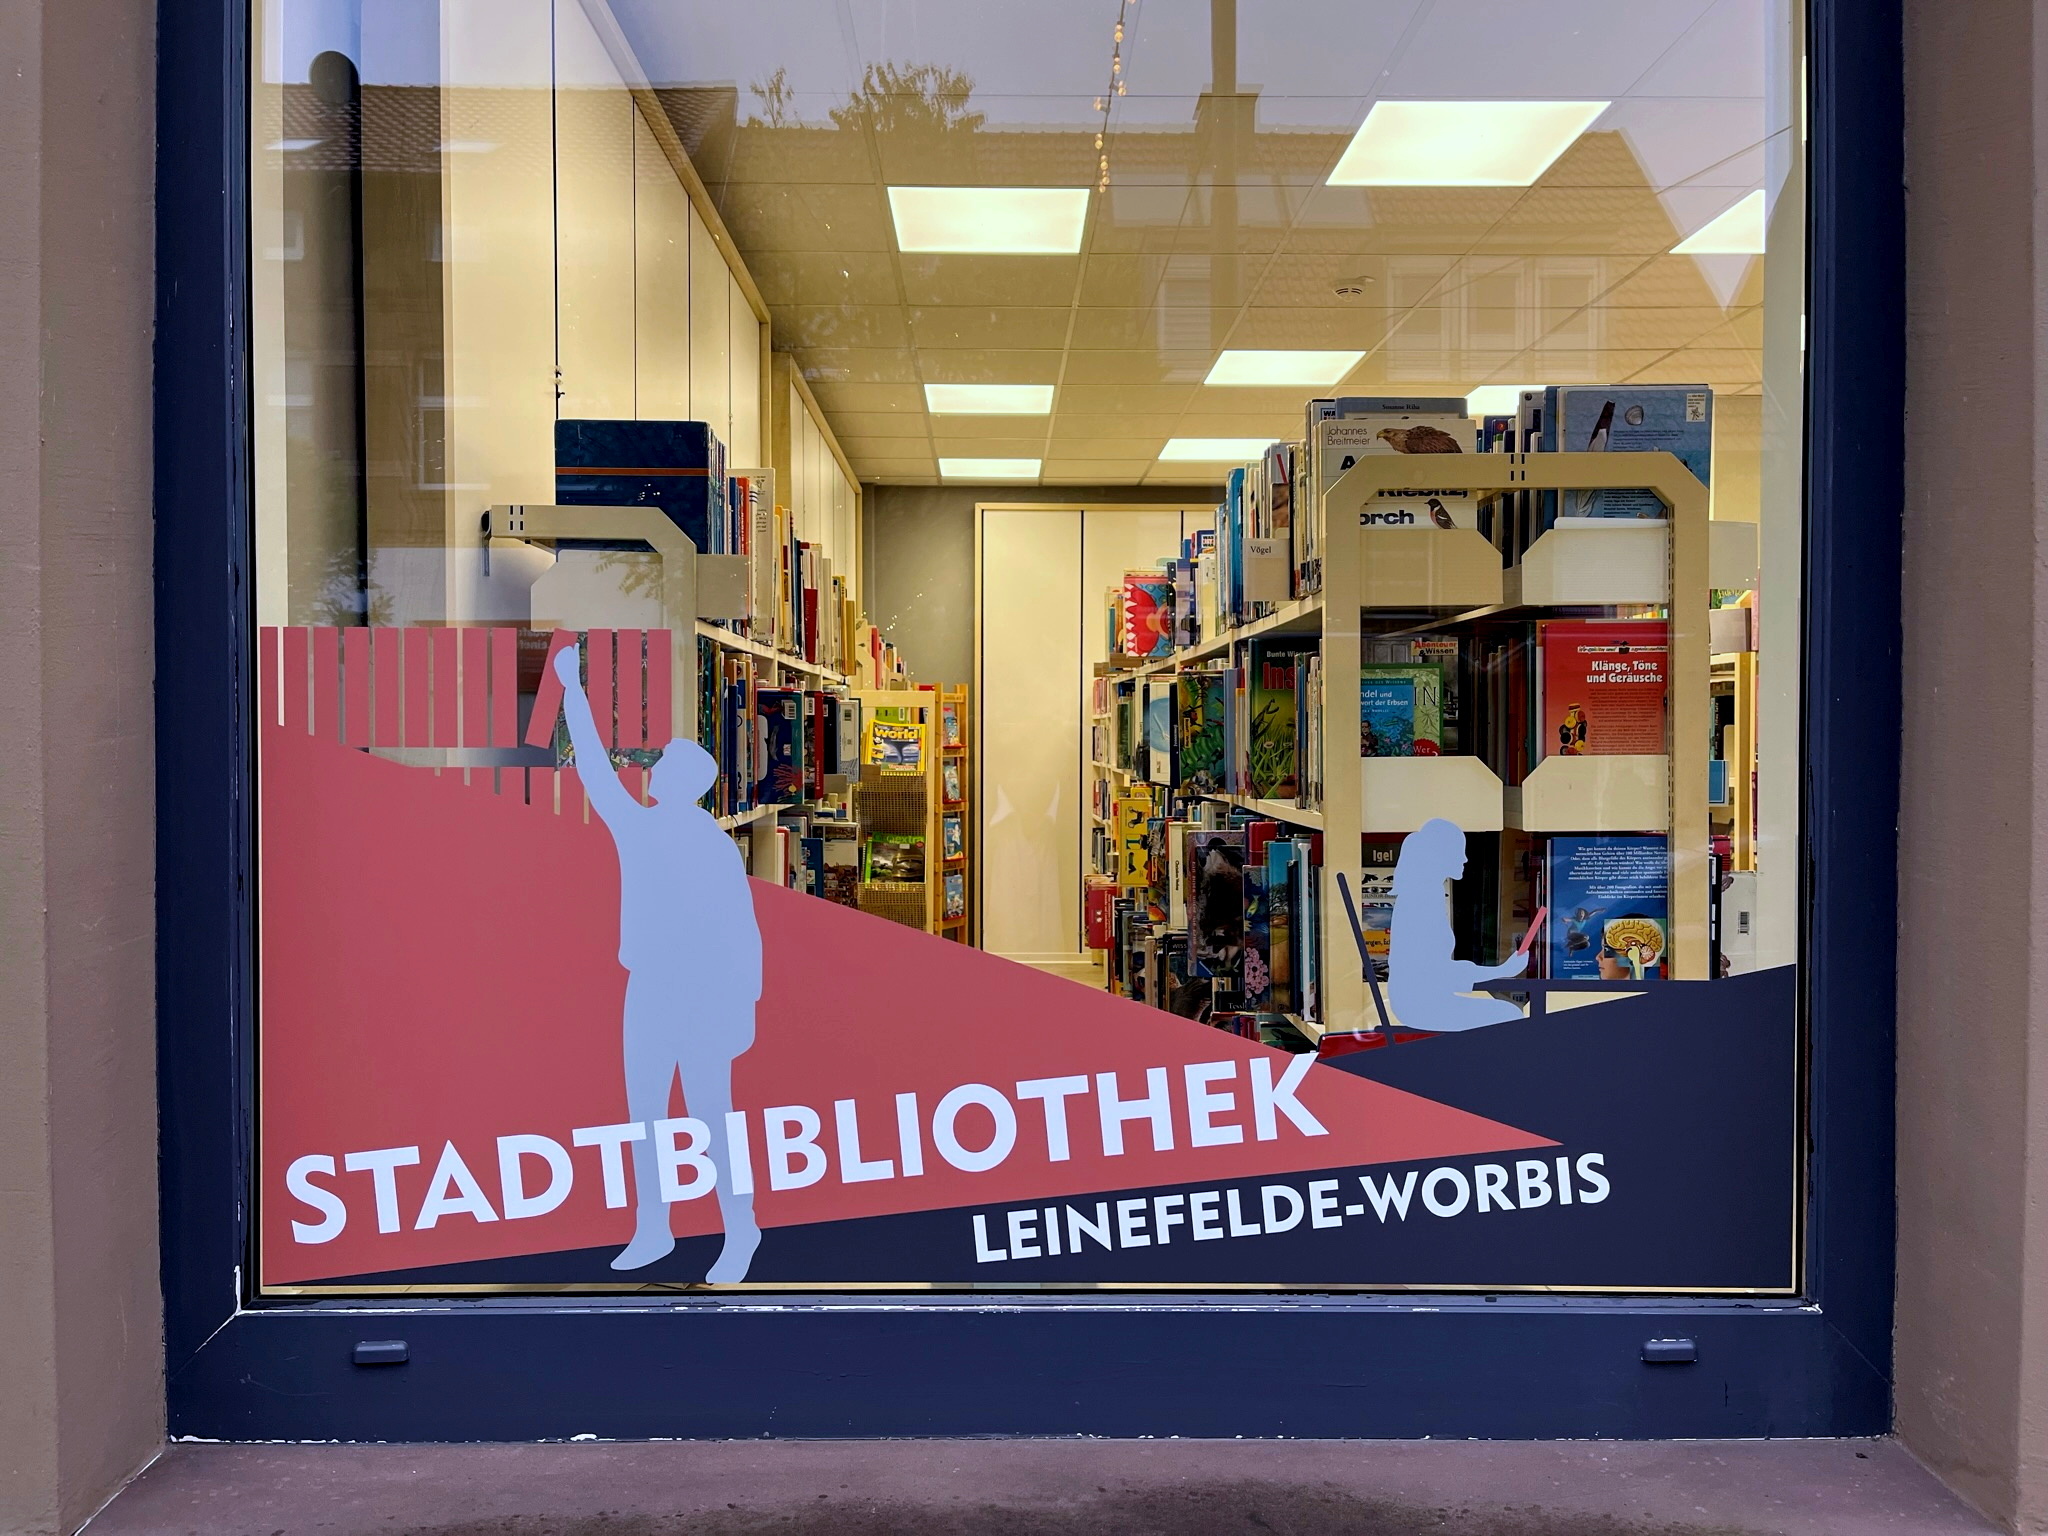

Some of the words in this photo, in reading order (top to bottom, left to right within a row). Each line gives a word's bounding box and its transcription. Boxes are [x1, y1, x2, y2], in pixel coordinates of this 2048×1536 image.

[1326, 426, 1368, 436] Johannes
[1327, 436, 1370, 446] Breitmeier
[1250, 545, 1272, 555] Vögel
[1414, 641, 1456, 649] Abenteuer
[1592, 660, 1631, 672] Klänge,
[1632, 660, 1658, 670] Töne
[1586, 673, 1606, 682] und
[1608, 672, 1662, 682] Geräusche
[874, 728, 918, 739] world
[895, 835, 924, 844] extra
[1372, 850, 1393, 862] Igel
[286, 1052, 1330, 1244] STADTBIBLIOTHEK
[972, 1152, 1610, 1262] LEINEFELDE-WORBIS
